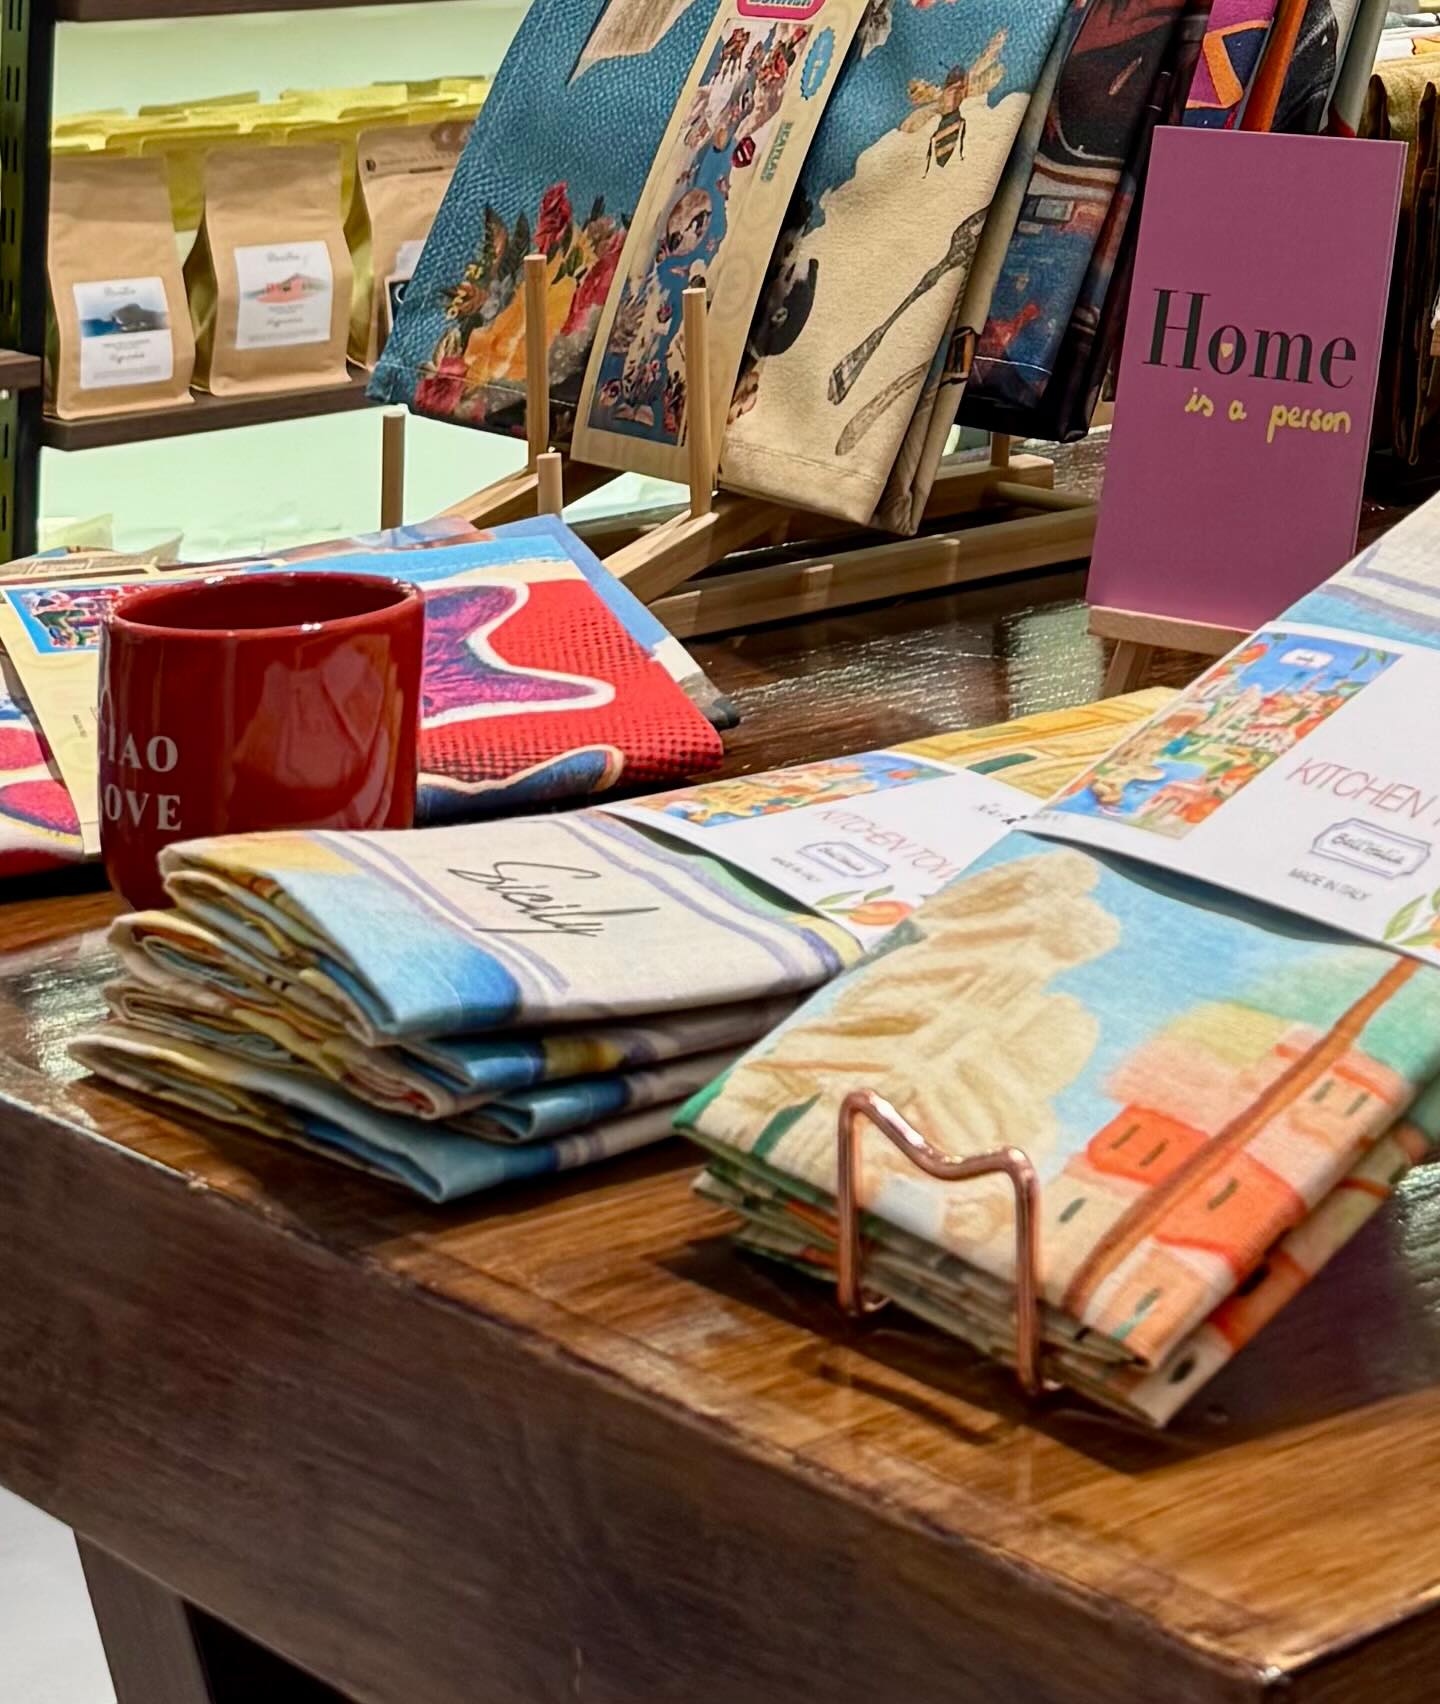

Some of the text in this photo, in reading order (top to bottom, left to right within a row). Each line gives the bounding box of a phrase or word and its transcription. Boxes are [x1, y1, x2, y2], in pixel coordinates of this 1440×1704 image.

[1141, 287, 1357, 390] Home
[1184, 386, 1352, 444] is a person
[108, 731, 179, 773] IAO
[103, 782, 183, 831] OVE
[1284, 757, 1438, 819] KITCHEN
[903, 847, 963, 881] TOW
[446, 860, 662, 938] Sicily
